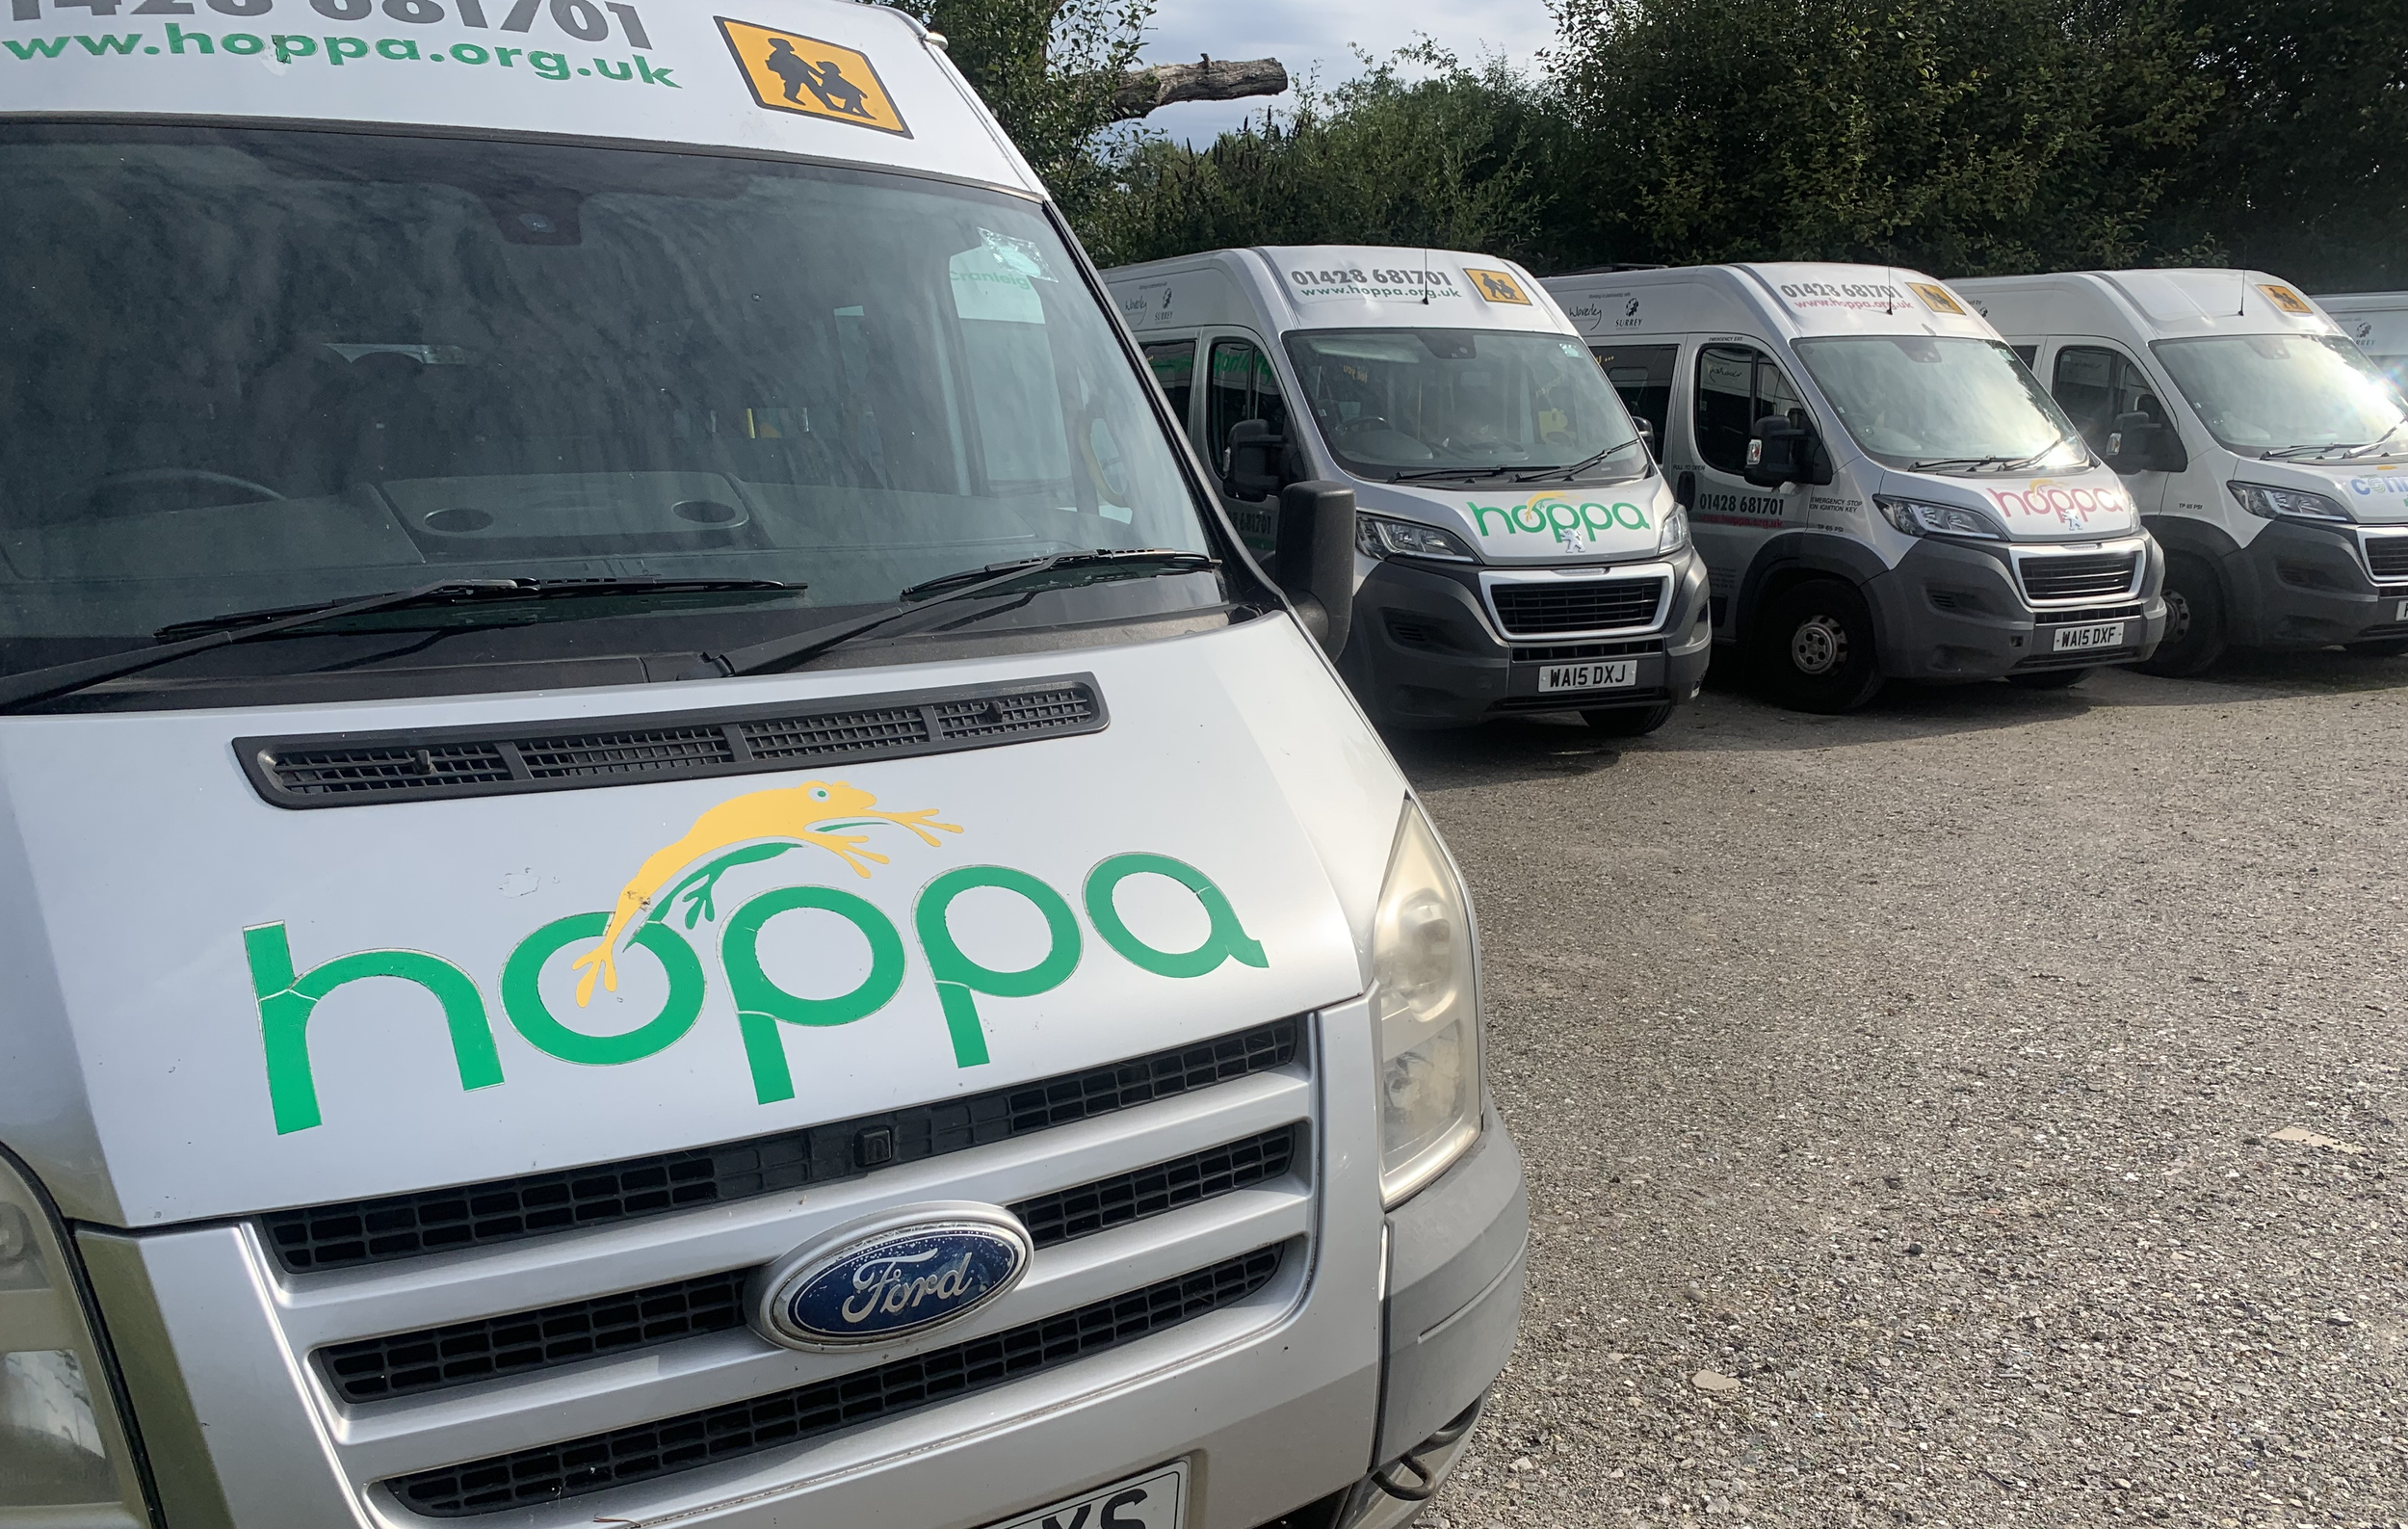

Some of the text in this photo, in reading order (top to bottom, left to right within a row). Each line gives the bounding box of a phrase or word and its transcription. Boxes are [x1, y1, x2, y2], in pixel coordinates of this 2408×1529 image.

[1291, 269, 1453, 287] 01428 681701
[1300, 285, 1462, 299] www.hoppa.org.uk
[1841, 284, 1904, 299] 681701
[1793, 298, 1915, 310] www.hoppa.org.uk
[1569, 303, 1602, 330] Waverley
[1614, 318, 1643, 327] SURREY
[1699, 493, 1784, 515] 01428 681701
[1811, 496, 1845, 506] EMERGENCY
[1986, 487, 2124, 523] hoppa
[1466, 501, 1651, 543] hoppa
[2062, 626, 2116, 647] WA15 DXF
[1550, 664, 1626, 688] WA15 DXJ
[244, 852, 1269, 1135] hoppa
[842, 1247, 973, 1324] Ford
